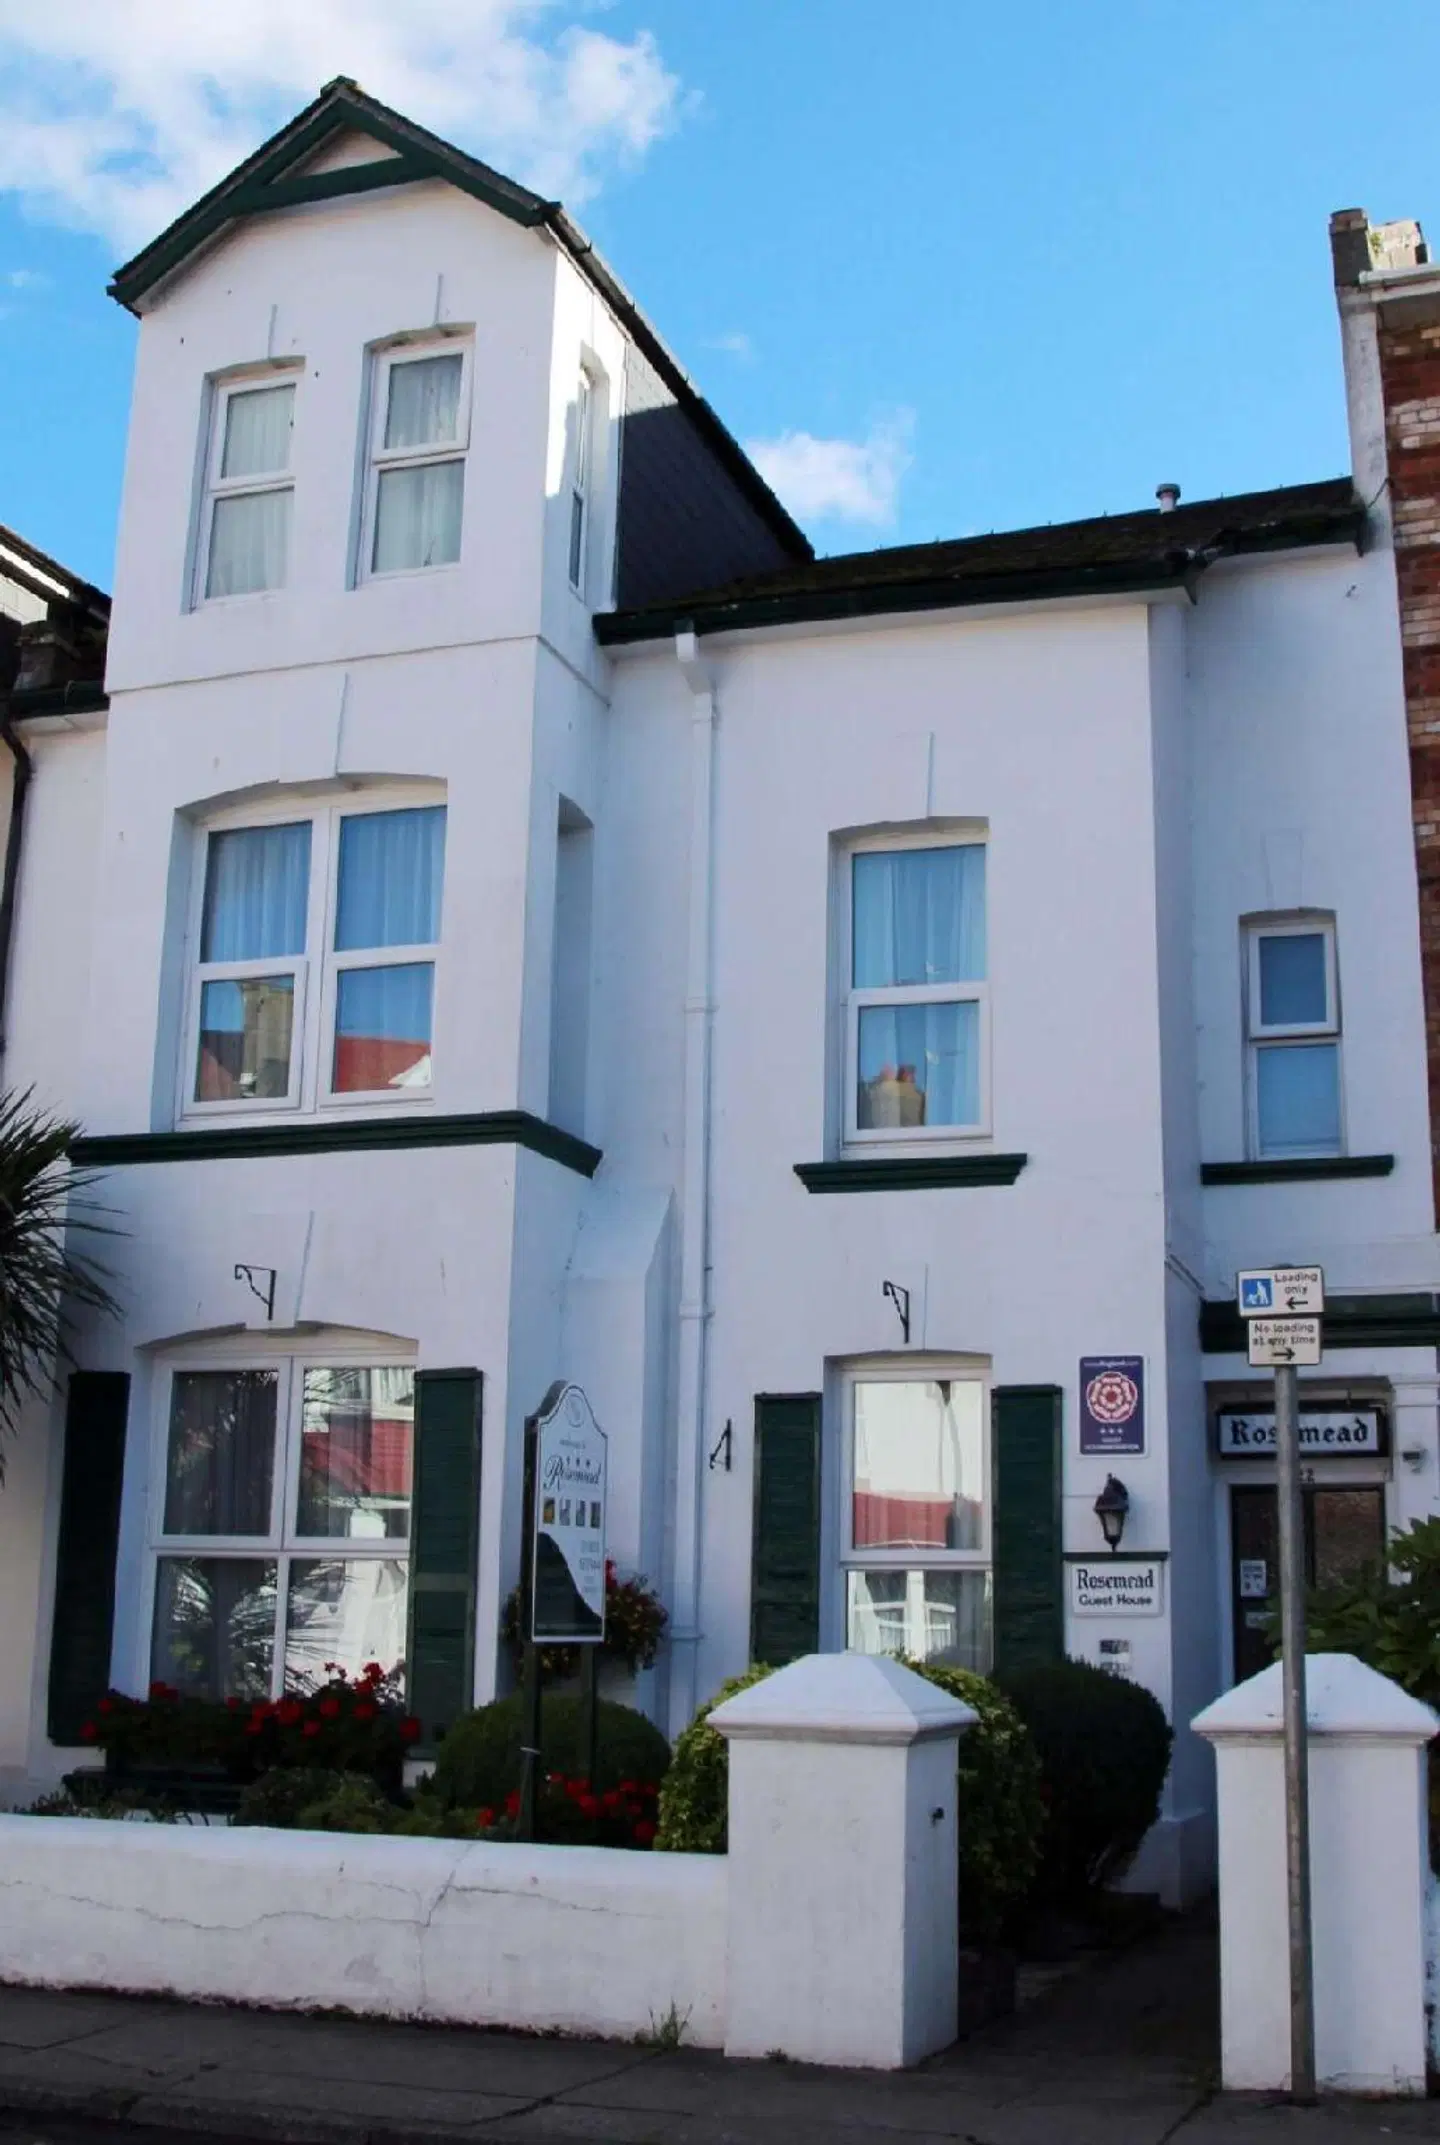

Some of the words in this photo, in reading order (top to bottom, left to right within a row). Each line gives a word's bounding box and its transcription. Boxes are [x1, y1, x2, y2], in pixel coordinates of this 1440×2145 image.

[1274, 1272, 1318, 1283] Loading
[1284, 1285, 1308, 1296] only
[1254, 1323, 1271, 1334] No
[1273, 1323, 1315, 1334] loading
[1252, 1336, 1265, 1346] at
[1267, 1337, 1286, 1347] any
[1290, 1335, 1317, 1345] time
[1230, 1418, 1368, 1446] Rosmead
[1077, 1568, 1154, 1589] Rosemead
[1078, 1593, 1113, 1606] Guest
[1116, 1593, 1153, 1606] House
